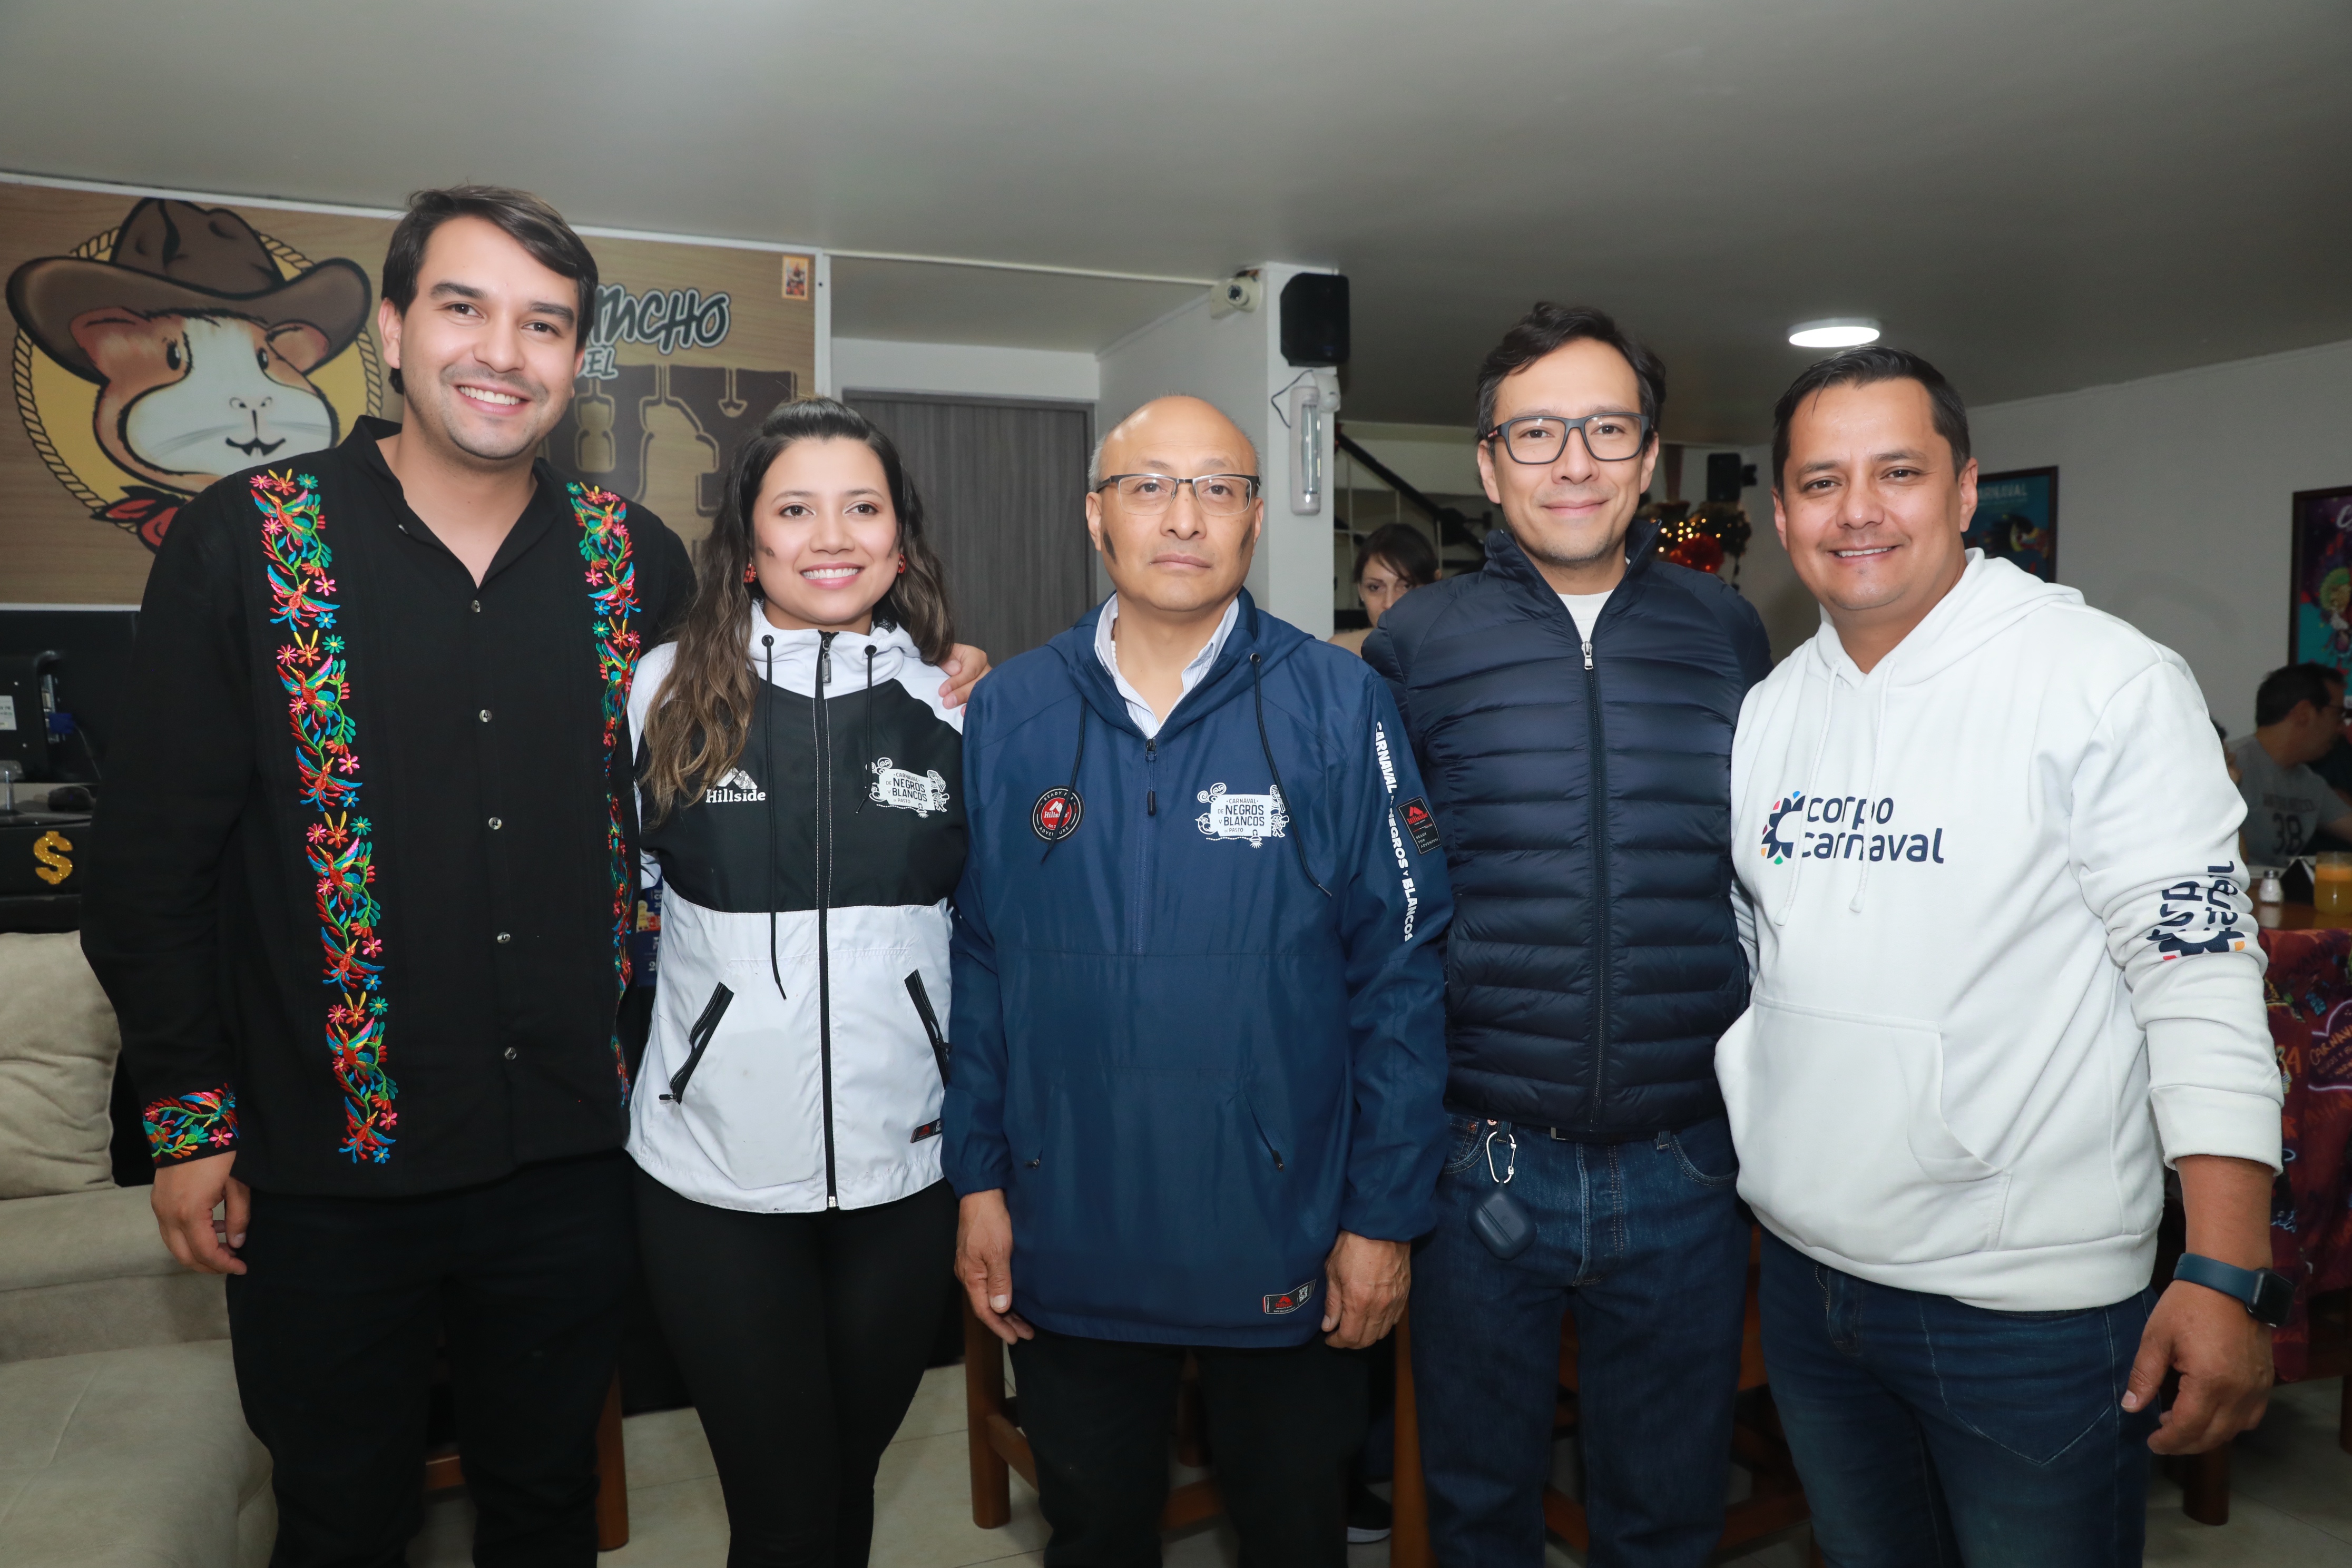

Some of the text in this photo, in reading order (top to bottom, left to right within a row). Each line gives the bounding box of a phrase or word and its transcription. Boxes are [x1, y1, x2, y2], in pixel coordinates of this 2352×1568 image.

[592, 284, 730, 355] NCHO
[579, 346, 619, 380] EL
[1977, 484, 2028, 499] ARNAVAL
[896, 772, 919, 782] CARNAVAL
[893, 778, 926, 792] NEGROS
[705, 788, 766, 803] Hillside
[892, 788, 927, 802] BLANCOS
[1044, 791, 1074, 801] READY FR
[1226, 805, 1264, 815] NEGROS
[1807, 796, 1894, 830] corpo
[1224, 816, 1265, 826] BLANCOS
[1407, 812, 1428, 825] Hillside
[1038, 826, 1069, 836] ADVEURE
[1375, 721, 1397, 793] CARNAVAL
[1388, 807, 1409, 869] NEGROS
[1402, 877, 1418, 942] BLANCOS
[1420, 837, 1439, 848] ADVENTURE
[1801, 828, 1944, 864] carnaval
[2309, 1024, 2352, 1066] CARNAV
